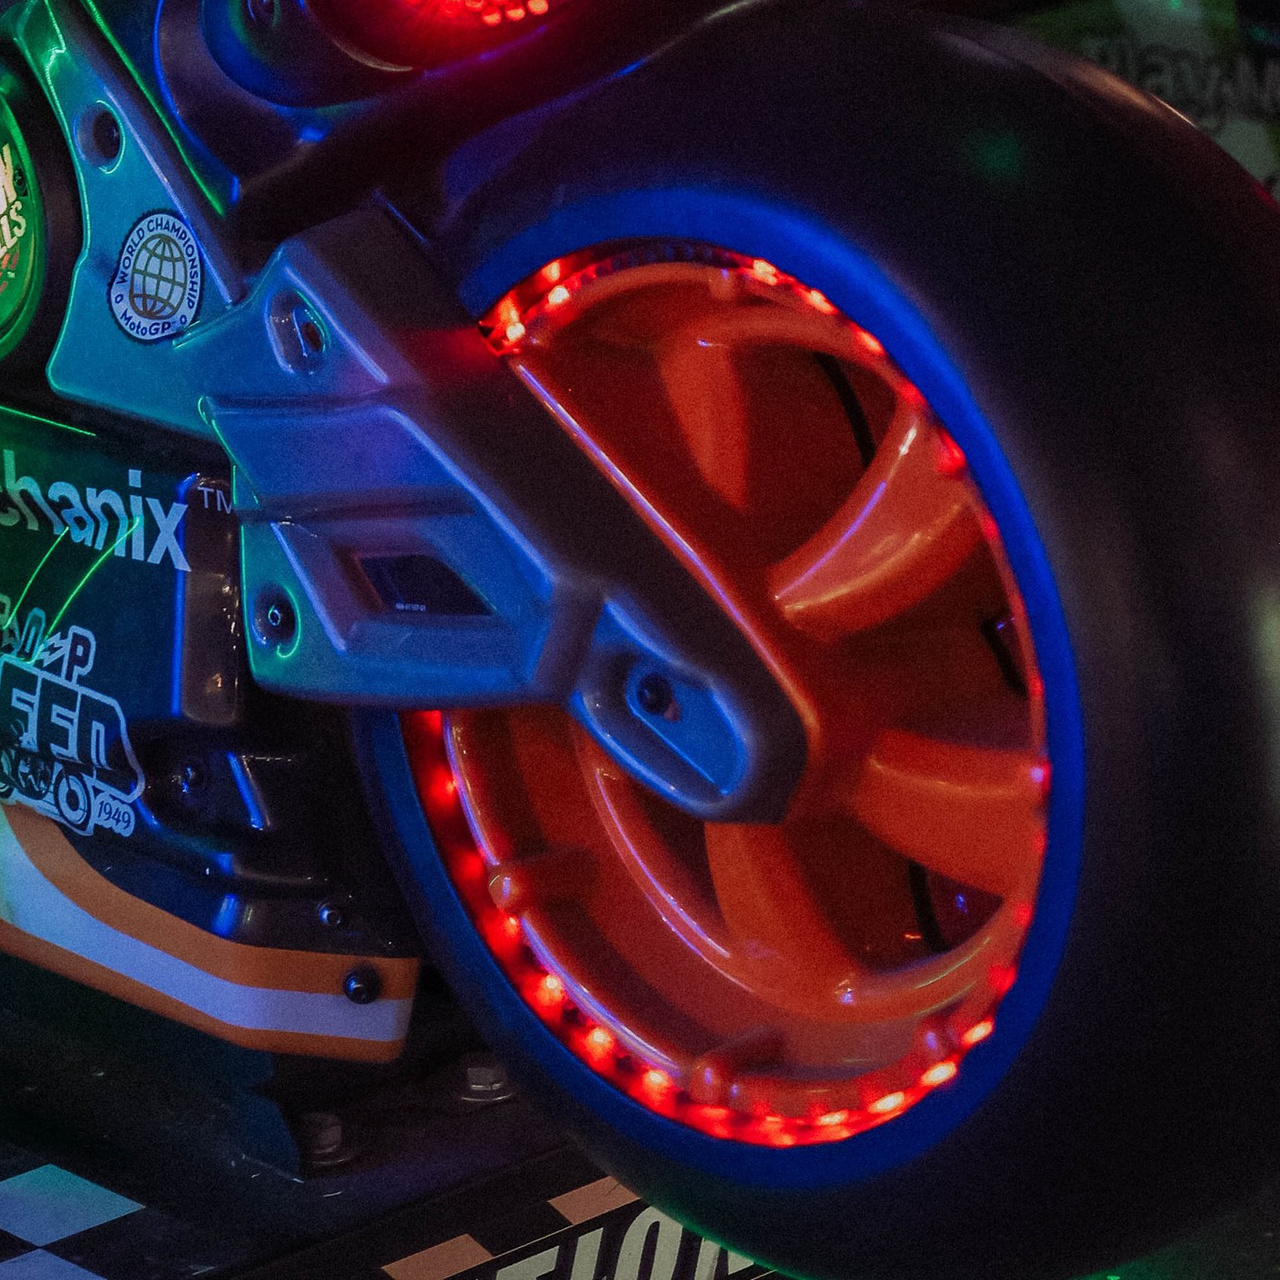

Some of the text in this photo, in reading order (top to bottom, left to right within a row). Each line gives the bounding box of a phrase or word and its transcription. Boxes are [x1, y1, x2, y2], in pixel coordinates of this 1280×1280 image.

[116, 216, 200, 310] WORLD CHAMPIONSHIP
[96, 799, 132, 832] 1949
